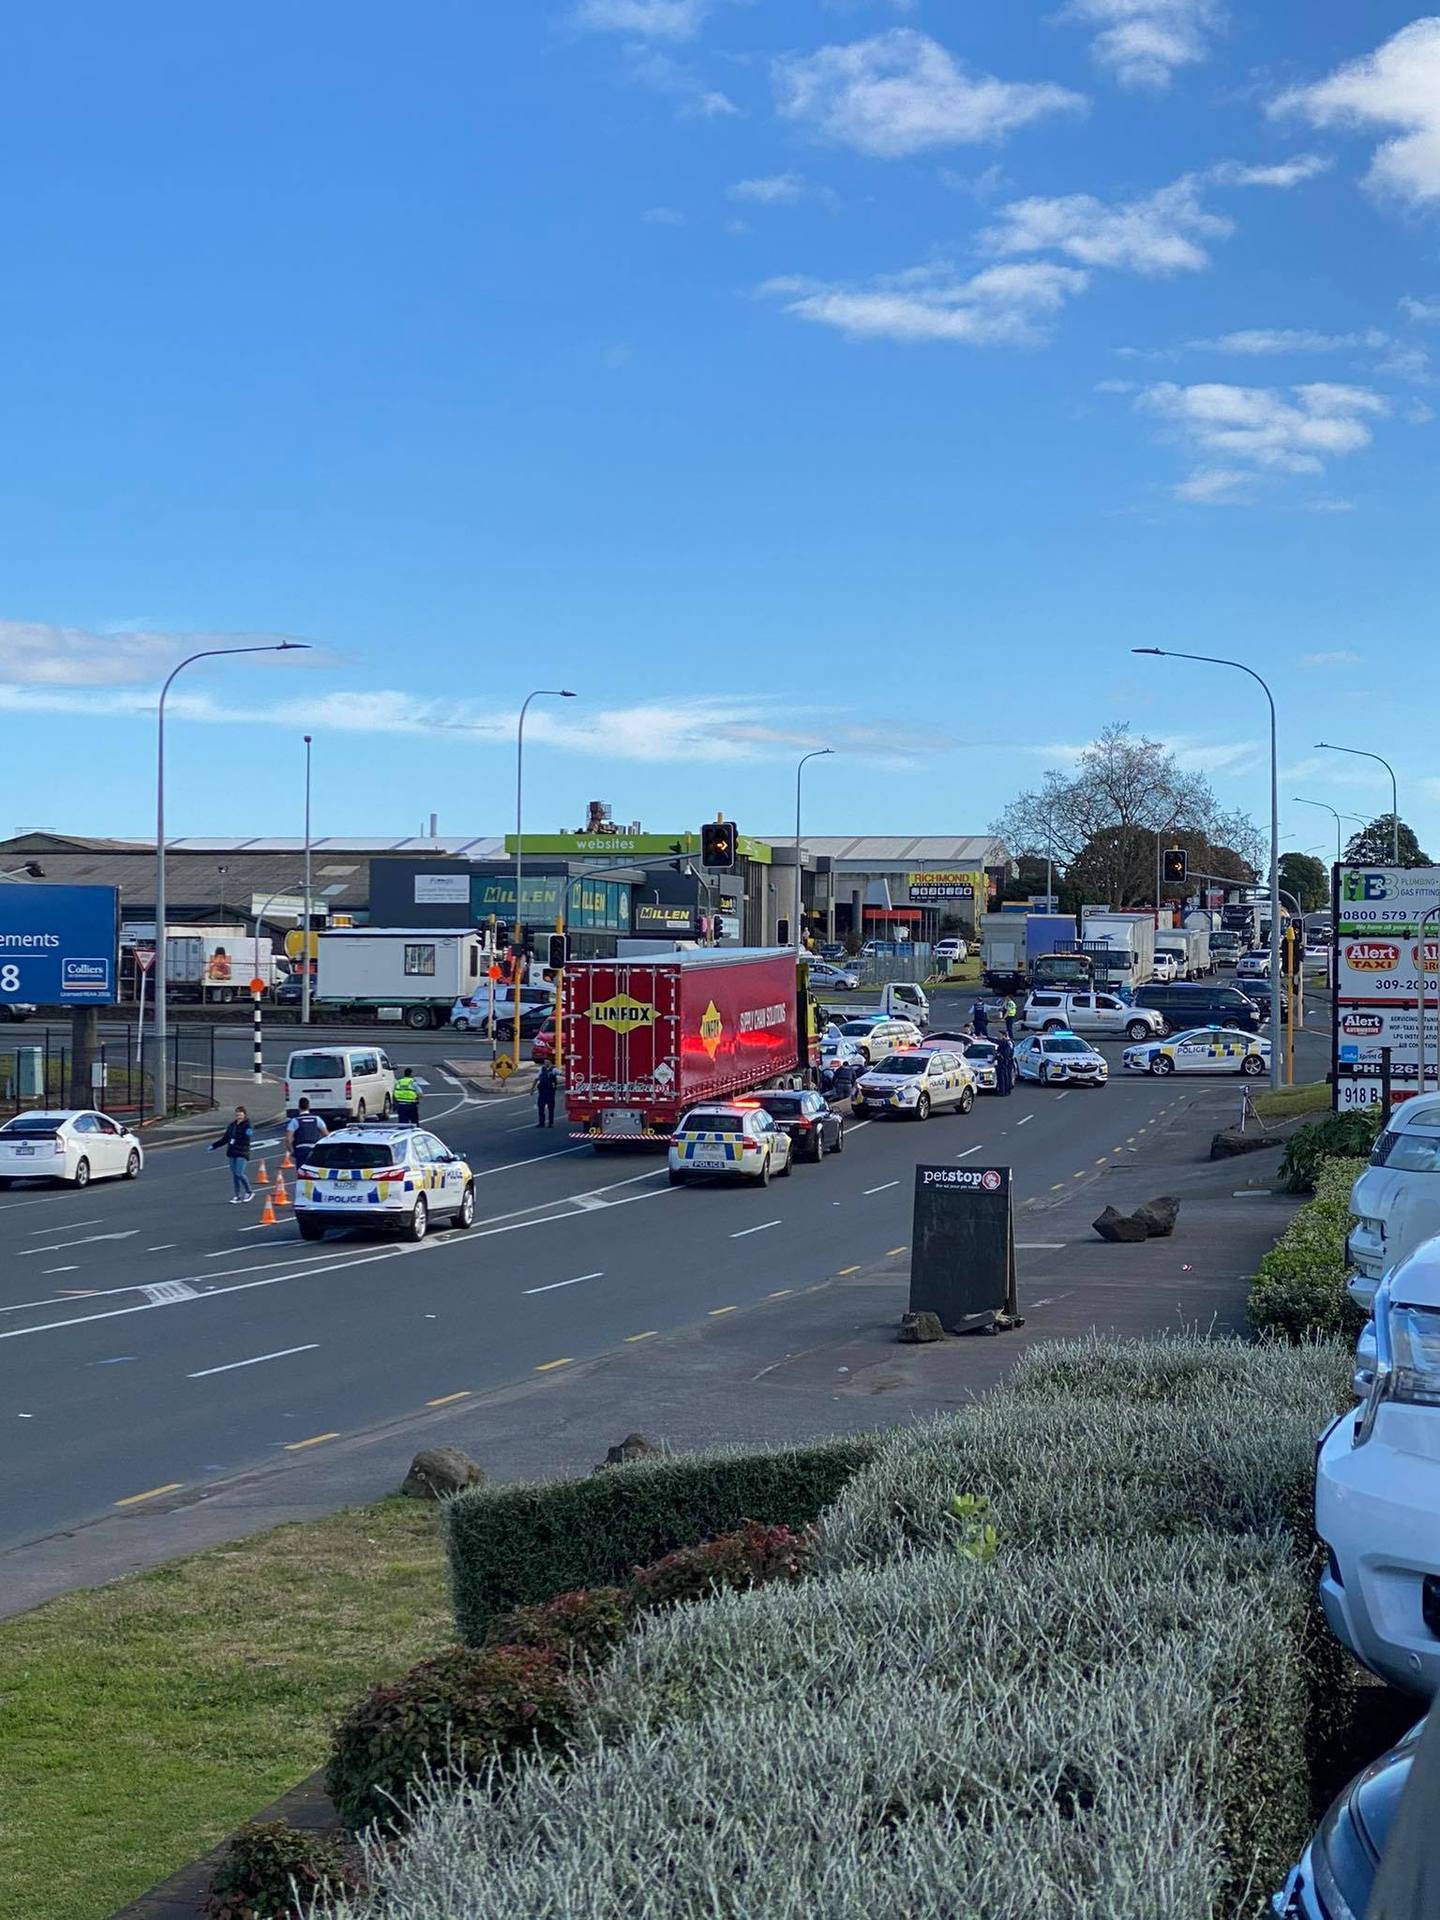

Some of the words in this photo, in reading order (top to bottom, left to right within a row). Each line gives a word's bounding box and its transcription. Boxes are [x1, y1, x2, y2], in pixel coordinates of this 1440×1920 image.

[576, 838, 635, 850] websites
[914, 873, 970, 882] RICHMOND
[483, 886, 557, 902] MILLEN
[572, 883, 606, 912] MILLEN
[1401, 888, 1414, 896] GAS
[640, 907, 690, 919] MILLEN
[1343, 911, 1377, 920] 0800
[1382, 911, 1407, 920] 579
[1349, 945, 1395, 959] Alert
[67, 963, 103, 974] Colliers
[1, 964, 20, 992] 8
[1376, 980, 1437, 990] 309-2000
[595, 1007, 650, 1021] LINFOX
[754, 1007, 767, 1030] CHAIN
[766, 1002, 786, 1027] SOLUTIONS
[1344, 1016, 1380, 1026] Alert
[1353, 1064, 1380, 1073] PH:
[1345, 1087, 1366, 1103] 918
[1370, 1087, 1378, 1103] B
[923, 1170, 982, 1185] petstop
